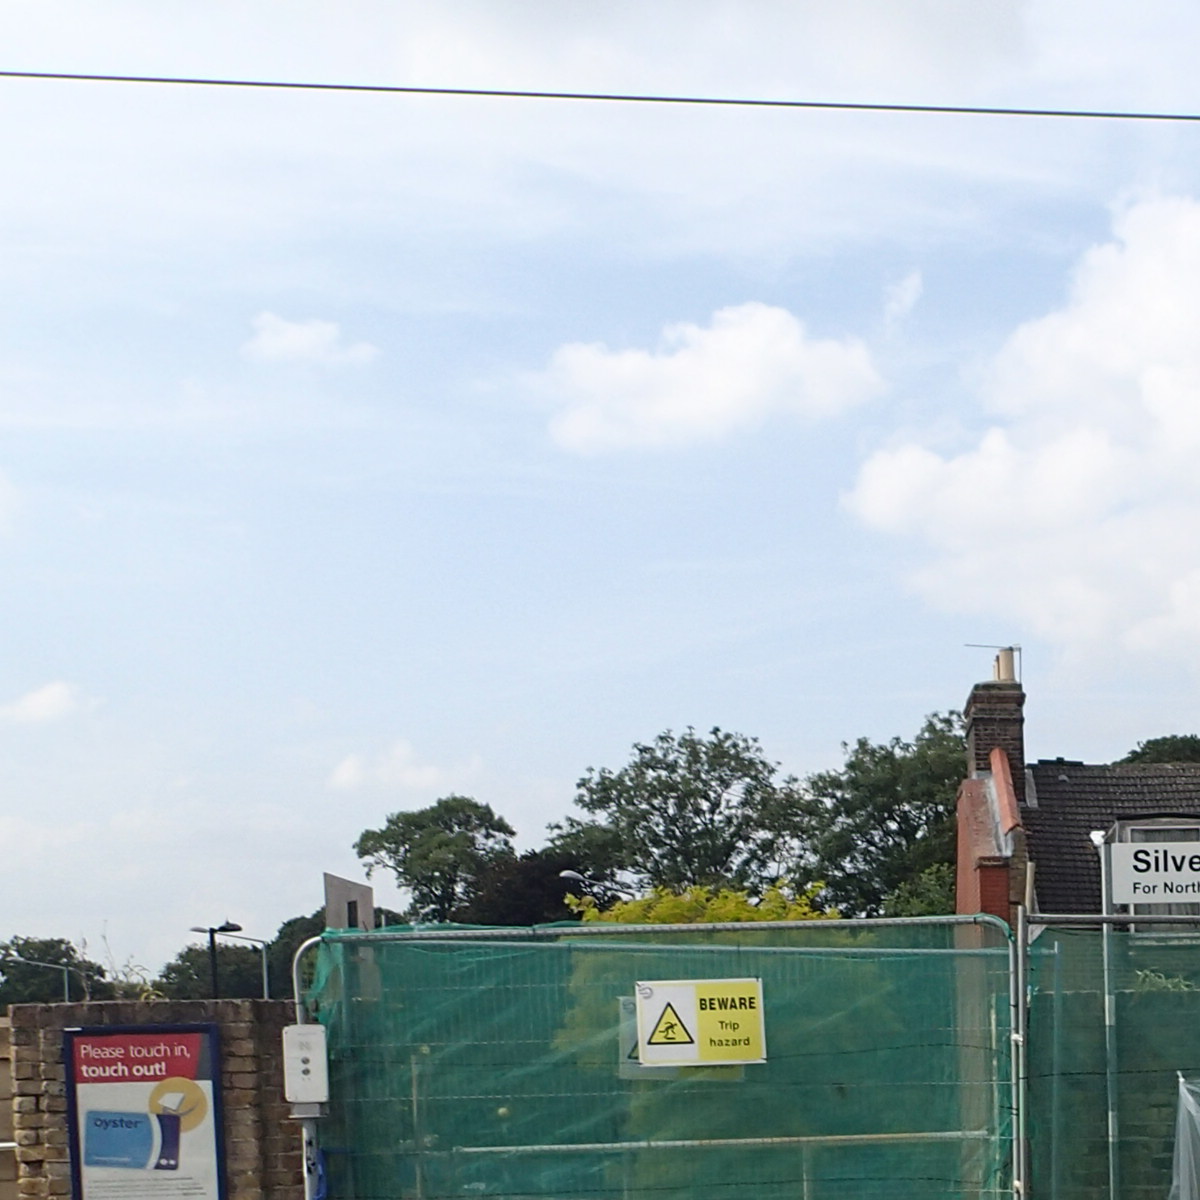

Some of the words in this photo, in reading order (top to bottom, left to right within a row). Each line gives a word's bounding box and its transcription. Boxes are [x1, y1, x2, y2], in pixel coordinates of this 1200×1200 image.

[1132, 881, 1157, 895] For
[699, 997, 757, 1010] BEWARE
[718, 1020, 740, 1032] Trip
[709, 1036, 750, 1047] hazard
[80, 1044, 125, 1059] Please
[130, 1043, 170, 1058] touch
[174, 1042, 191, 1058] in,
[81, 1063, 128, 1078] touch
[132, 1063, 167, 1076] out!
[94, 1116, 144, 1130] oyster
